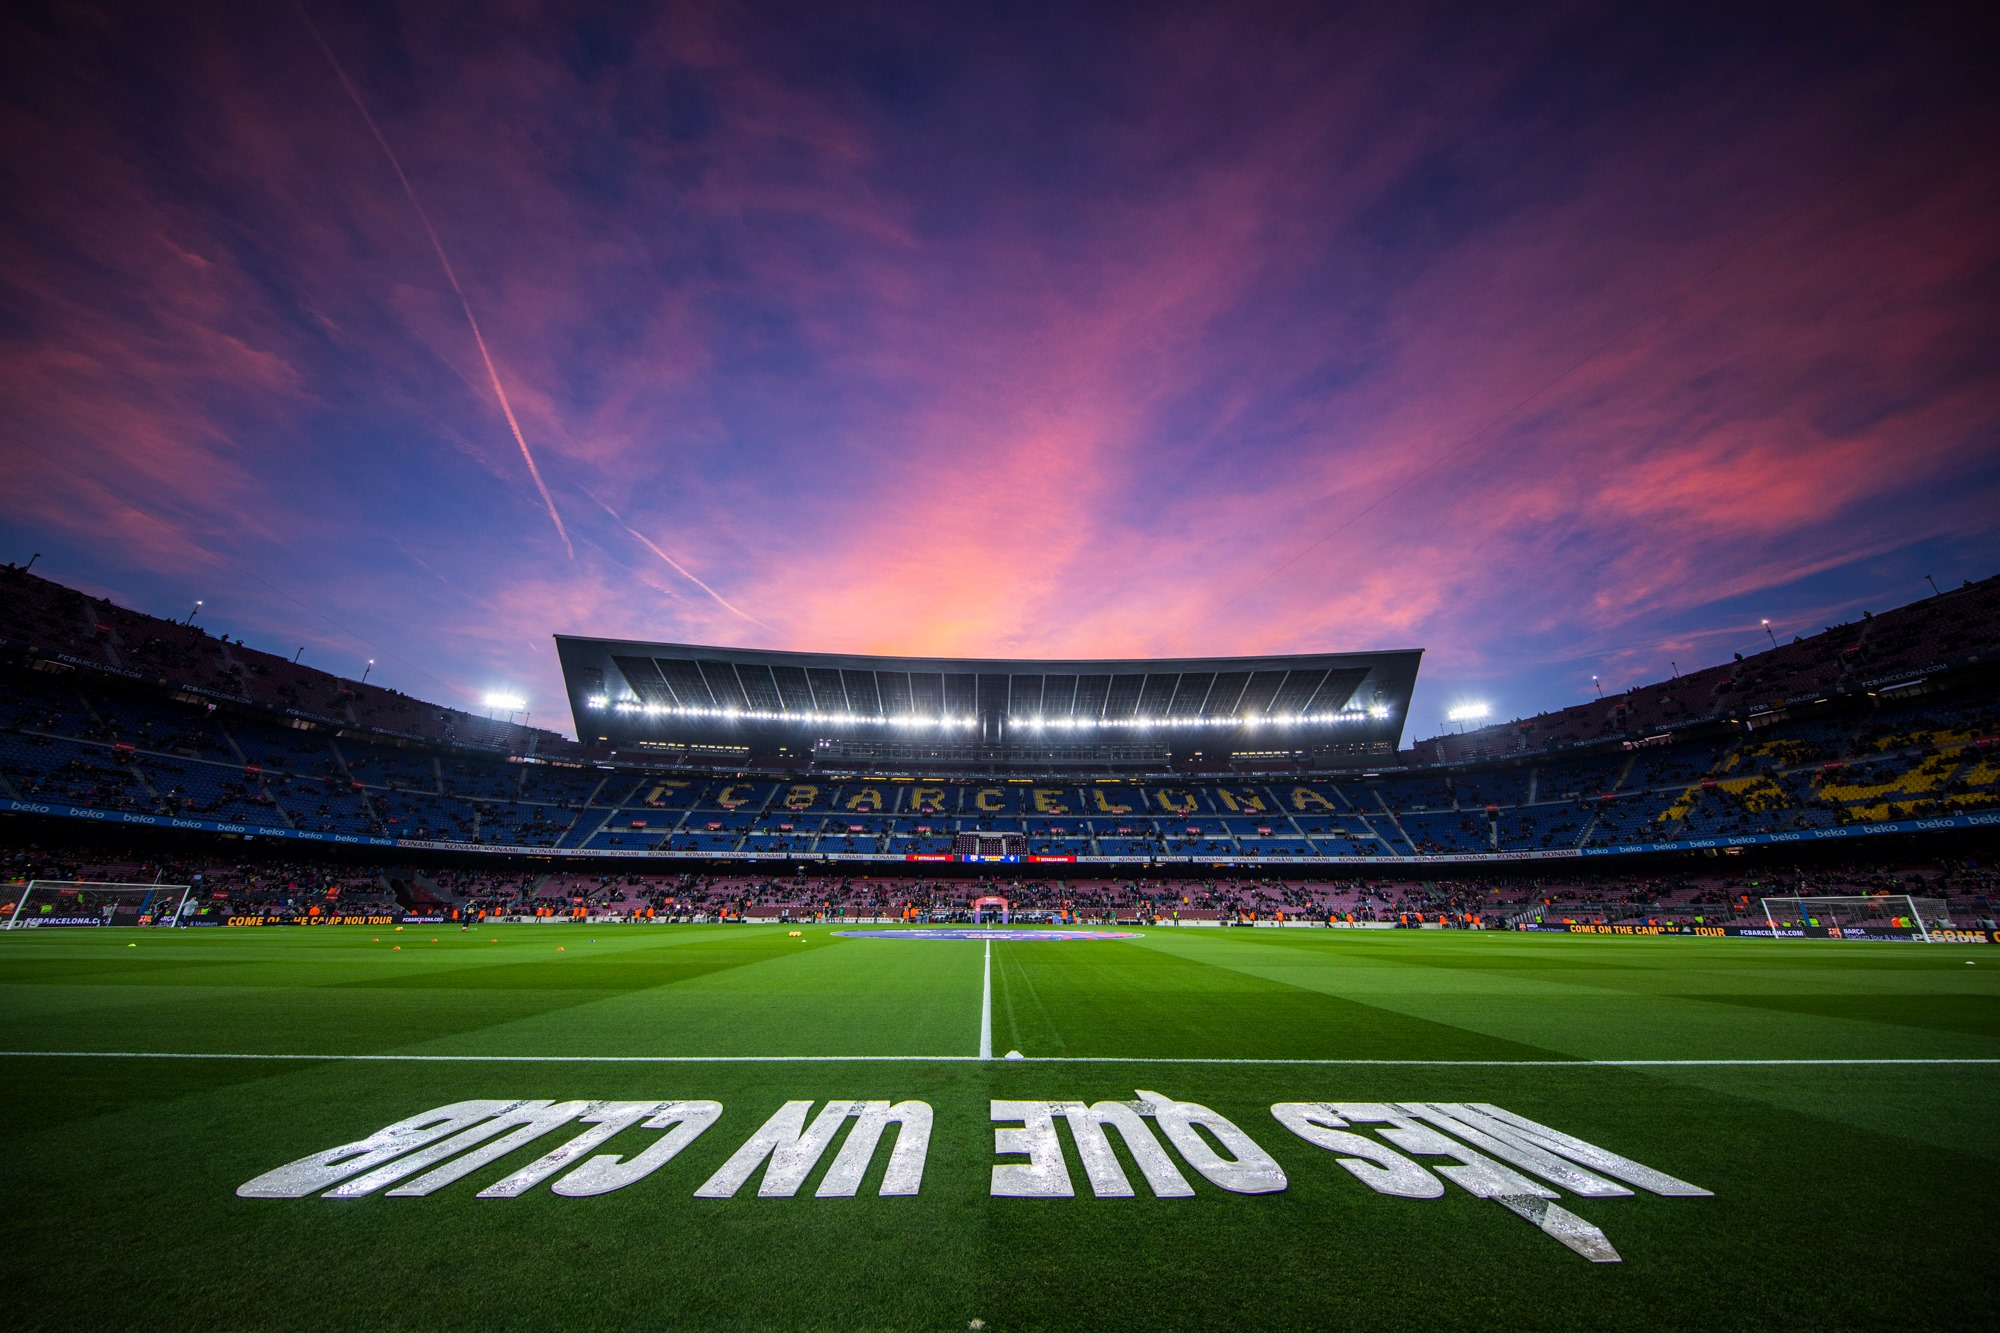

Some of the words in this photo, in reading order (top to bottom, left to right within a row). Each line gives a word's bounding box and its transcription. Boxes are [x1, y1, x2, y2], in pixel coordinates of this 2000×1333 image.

[58, 652, 143, 681] FCBARCELONA.COM
[1861, 662, 1949, 689] FCBARCELONA.COM
[182, 683, 254, 705] FCBARCELONA.COM
[1749, 692, 1820, 713] FCBAONA.COM
[286, 708, 346, 726] FCBARCELONA.COM
[1655, 714, 1717, 732] FCBARCELONA.COM
[372, 726, 427, 741] FCBARCELONA.COM
[1573, 733, 1626, 747] FCBARCELONA.COM
[11, 801, 50, 814] beko
[69, 807, 105, 820] beko
[123, 812, 155, 825] beko
[172, 818, 204, 830] beko
[217, 822, 245, 834] beko
[1862, 824, 1898, 834] beko
[1916, 819, 1955, 829] beko
[259, 826, 286, 837] beko
[299, 830, 323, 841] beko
[1814, 829, 1847, 838] beko
[335, 834, 358, 844] beko
[370, 838, 392, 847] beko
[1728, 836, 1756, 845] beko
[1770, 833, 1800, 842] beko
[398, 840, 434, 848] KONAMI
[444, 843, 480, 852] KONAMI
[1619, 845, 1642, 853] beko
[1653, 843, 1678, 851] beko
[1690, 839, 1716, 848] beko
[484, 846, 519, 854] KONAMI
[530, 848, 562, 856] KONAMI
[1542, 850, 1577, 858] KONAMI
[227, 916, 264, 926] COME
[344, 916, 366, 926] NOU
[367, 916, 393, 926] TOUR
[1570, 925, 1597, 934] COME
[1598, 925, 1612, 934] ON
[1613, 925, 1634, 934] THE
[1693, 927, 1726, 937] TOUR
[235, 1099, 724, 1198] CLUB
[693, 1099, 934, 1198] UN
[990, 1089, 1288, 1198] QUE
